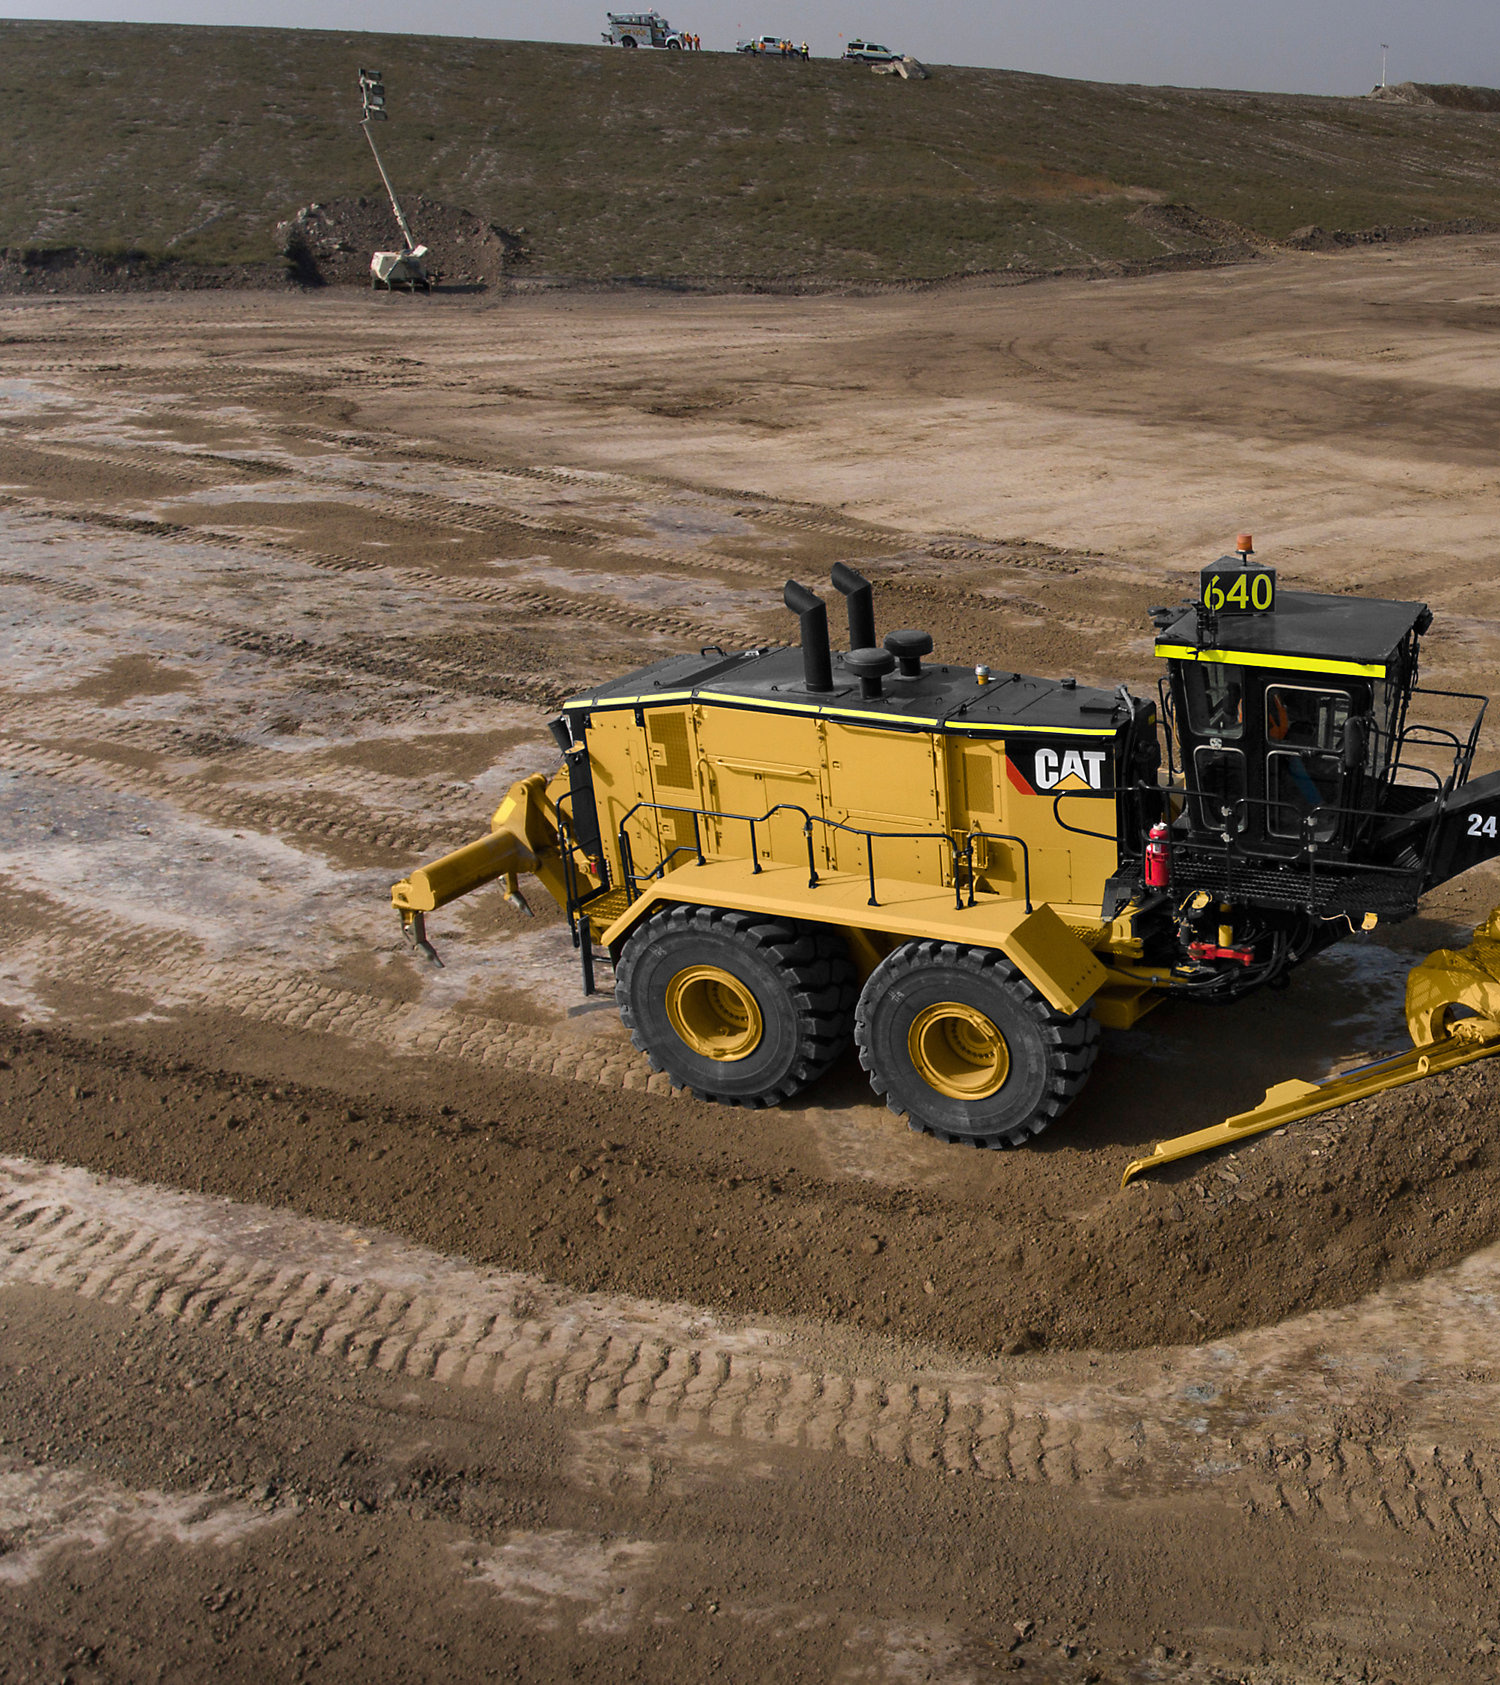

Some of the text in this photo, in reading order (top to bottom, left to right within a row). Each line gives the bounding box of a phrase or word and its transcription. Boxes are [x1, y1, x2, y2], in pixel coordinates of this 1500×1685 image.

[1204, 574, 1273, 611] 640
[1035, 748, 1106, 790] CAT
[1467, 813, 1498, 838] 24
